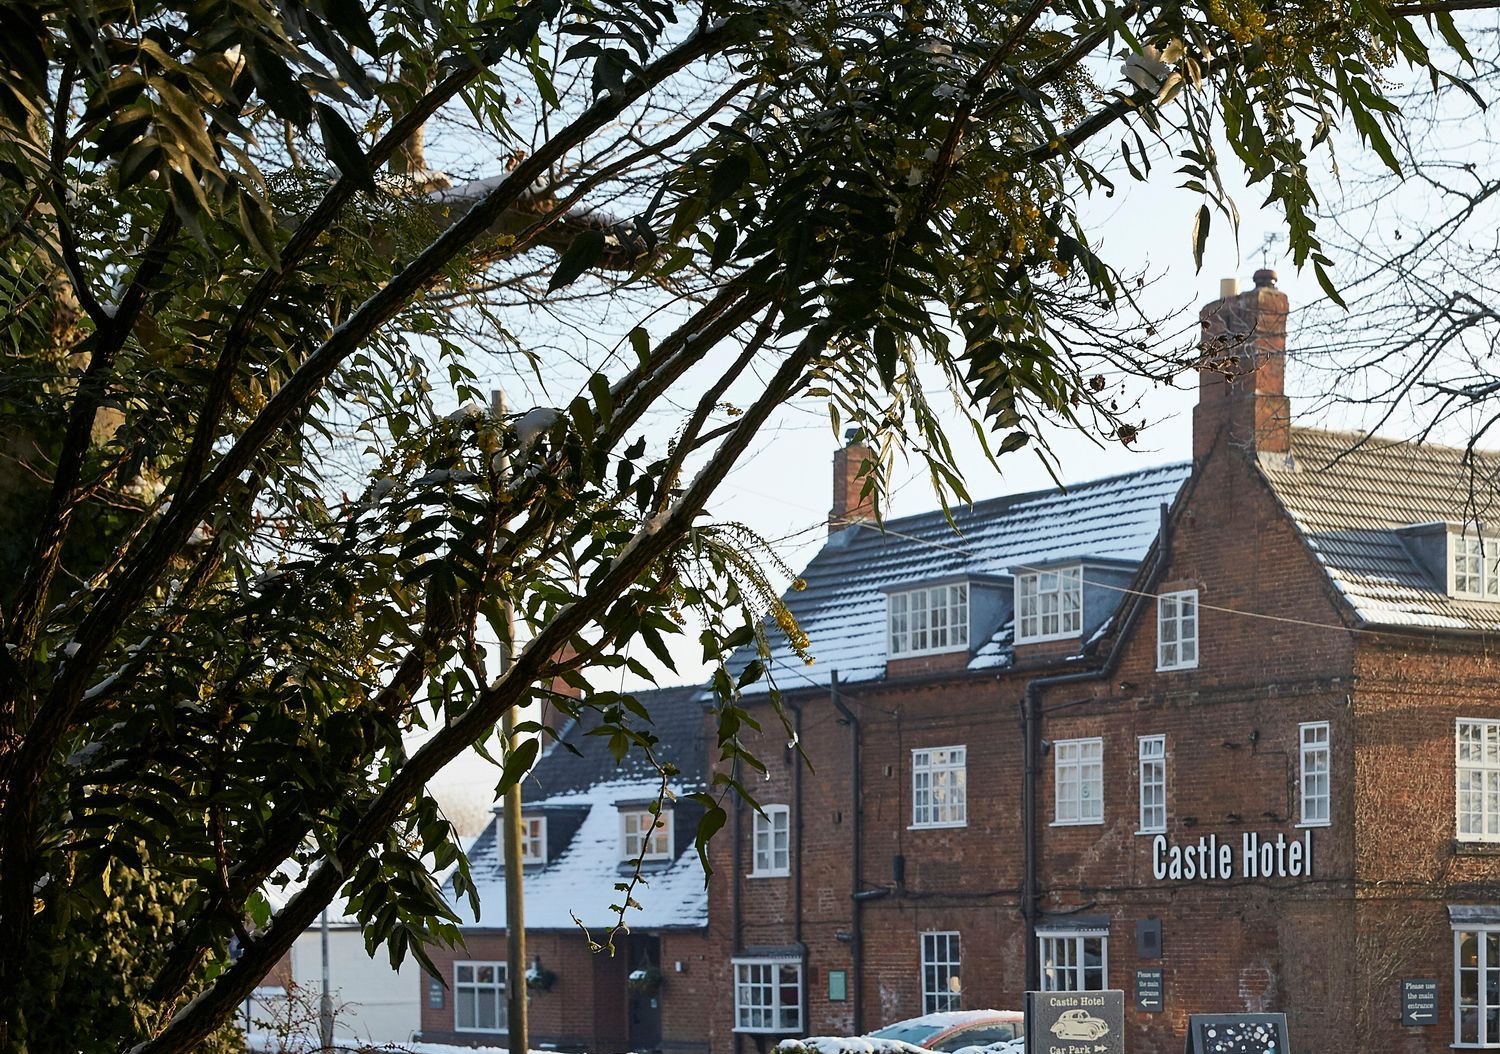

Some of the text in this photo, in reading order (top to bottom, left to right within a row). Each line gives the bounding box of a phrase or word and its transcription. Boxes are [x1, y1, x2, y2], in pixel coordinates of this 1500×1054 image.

[1152, 829, 1311, 880] Castle Hotel
[1050, 996, 1105, 1007] Castle Hotel
[1049, 1045, 1091, 1054] Car Park
